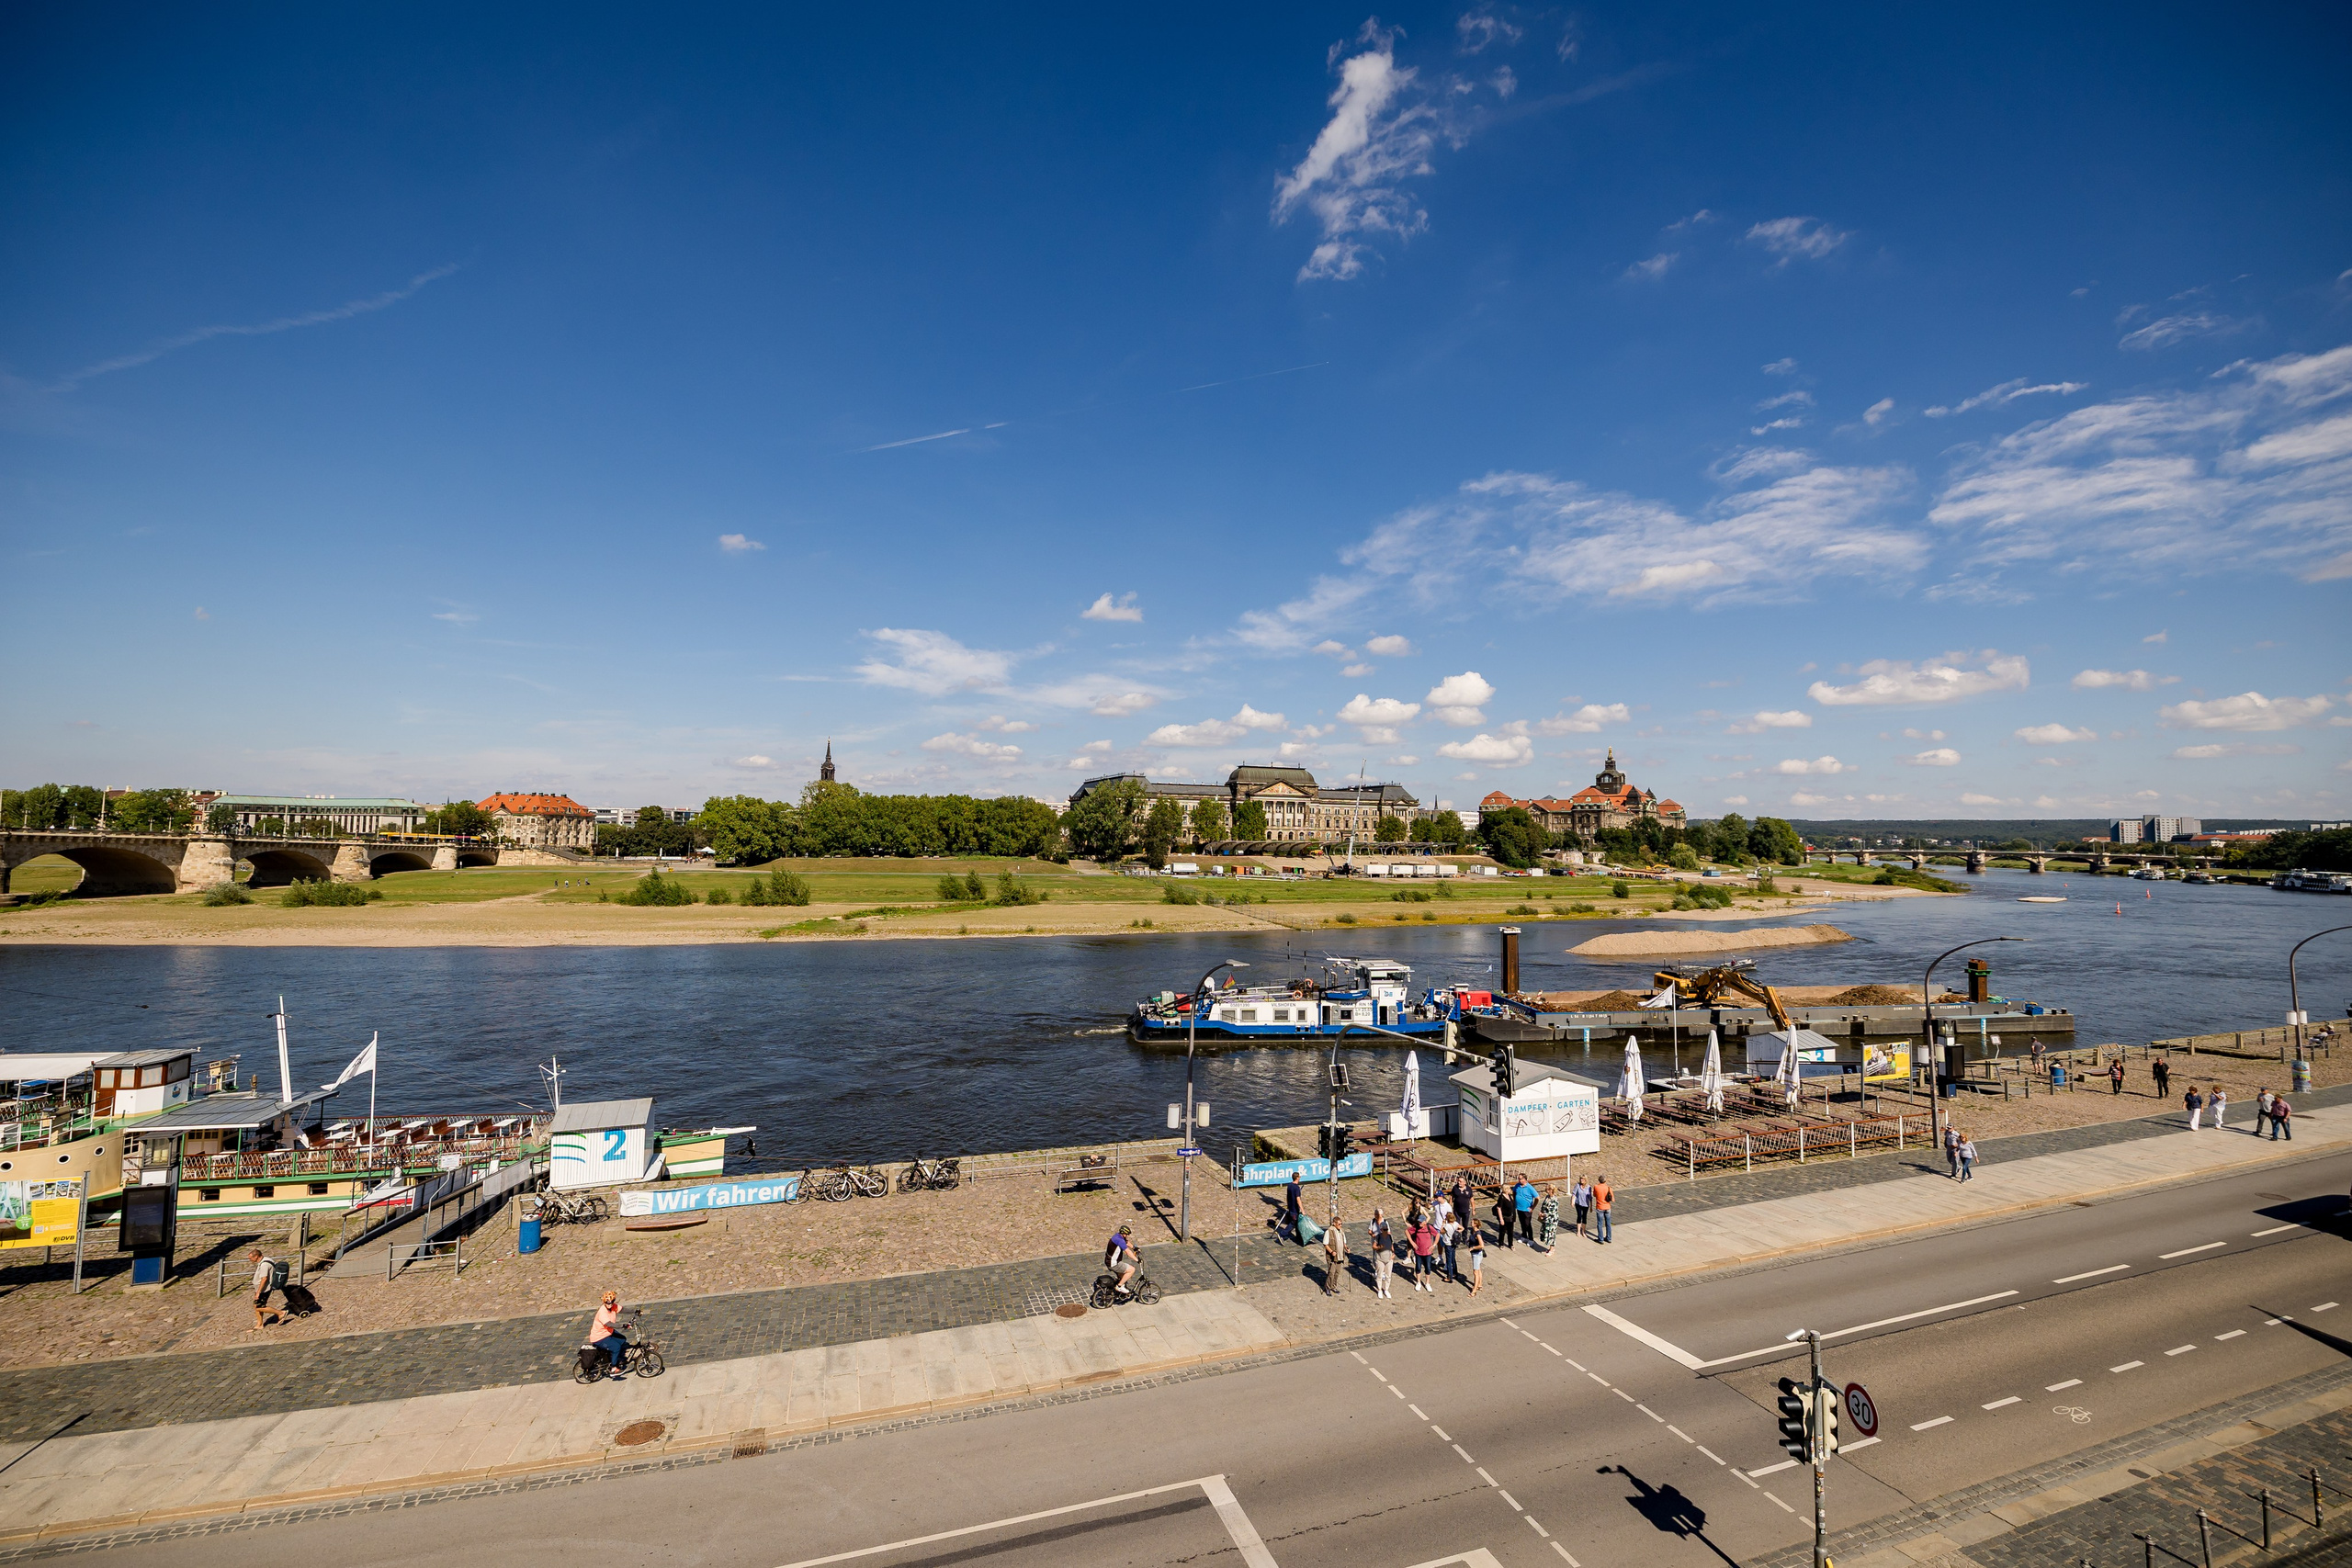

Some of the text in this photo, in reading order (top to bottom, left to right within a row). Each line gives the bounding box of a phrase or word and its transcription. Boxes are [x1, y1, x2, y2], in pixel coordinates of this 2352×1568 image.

[1815, 1049, 1825, 1062] 3
[1508, 1100, 1590, 1113] DAMPFER GARTEN
[603, 1129, 626, 1161] 2
[1243, 1160, 1351, 1182] ahrplan & Ticet
[656, 1184, 795, 1211] Wir fahren!
[1851, 1394, 1871, 1425] 30
